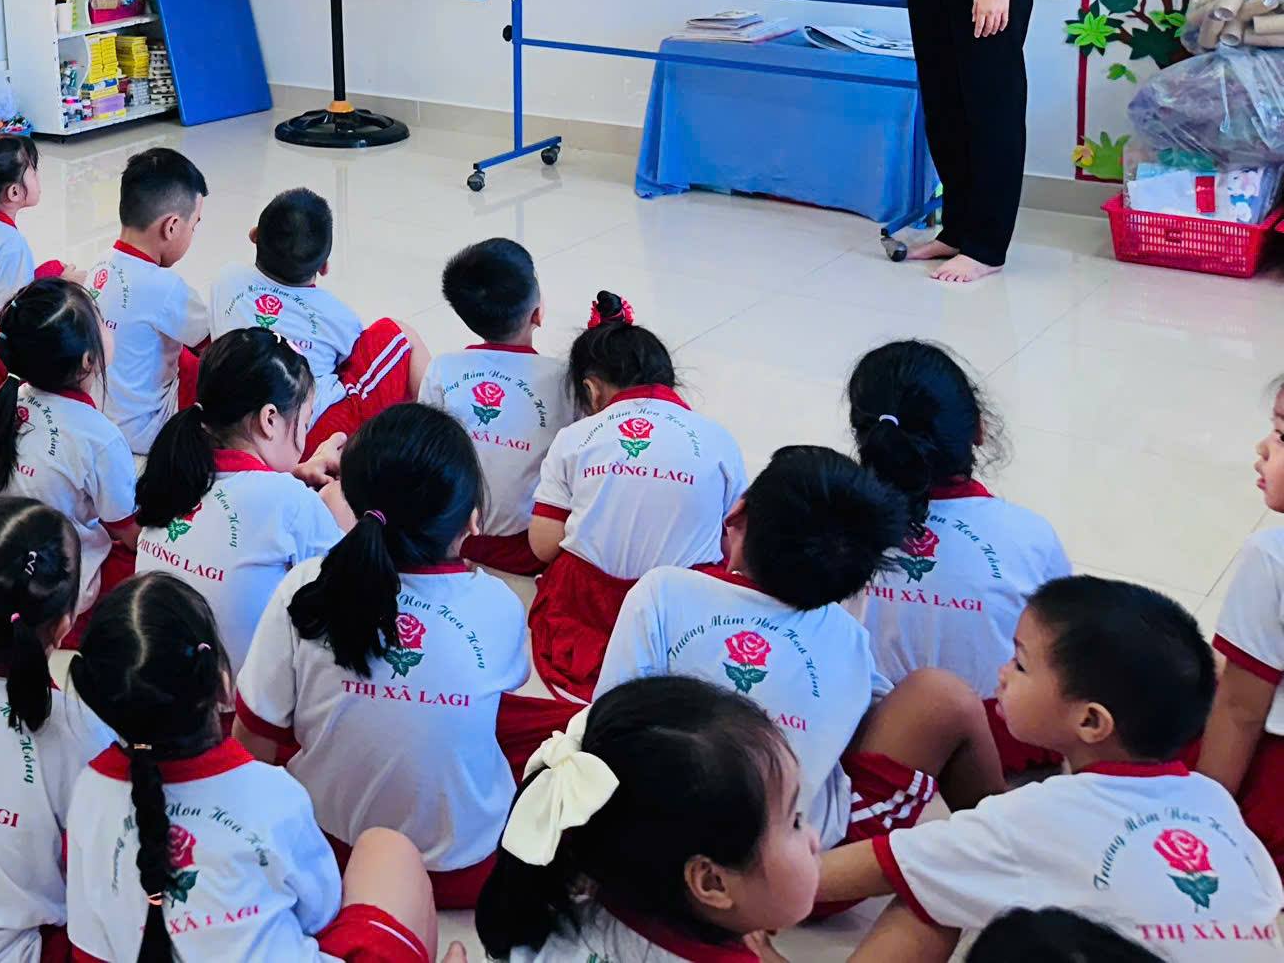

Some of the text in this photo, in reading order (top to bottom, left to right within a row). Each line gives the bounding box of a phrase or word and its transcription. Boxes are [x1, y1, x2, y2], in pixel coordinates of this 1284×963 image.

[488, 369, 512, 382] Non
[516, 379, 534, 398] Hoa
[665, 413, 686, 430] Hoa
[472, 430, 532, 452] XÃ LAGI
[15, 462, 35, 478] AGI
[583, 462, 695, 486] PHƯỜNG LAGI
[214, 489, 230, 512] Hoa
[928, 513, 946, 525] on
[954, 519, 980, 542] Hoa
[184, 558, 225, 582] LAGI
[865, 585, 982, 612] THỊ XÃ LAGI
[398, 593, 432, 611] Non
[436, 604, 465, 630] Hoa
[750, 616, 779, 632] Non
[782, 628, 807, 656] Hoa
[341, 680, 471, 707] THỊ XÃ LAGI
[772, 712, 808, 732] AGI
[164, 802, 243, 834] Non Hoa
[169, 910, 199, 935] XÃ
[1136, 923, 1185, 944] THỊ
[1192, 919, 1226, 941] XÃ
